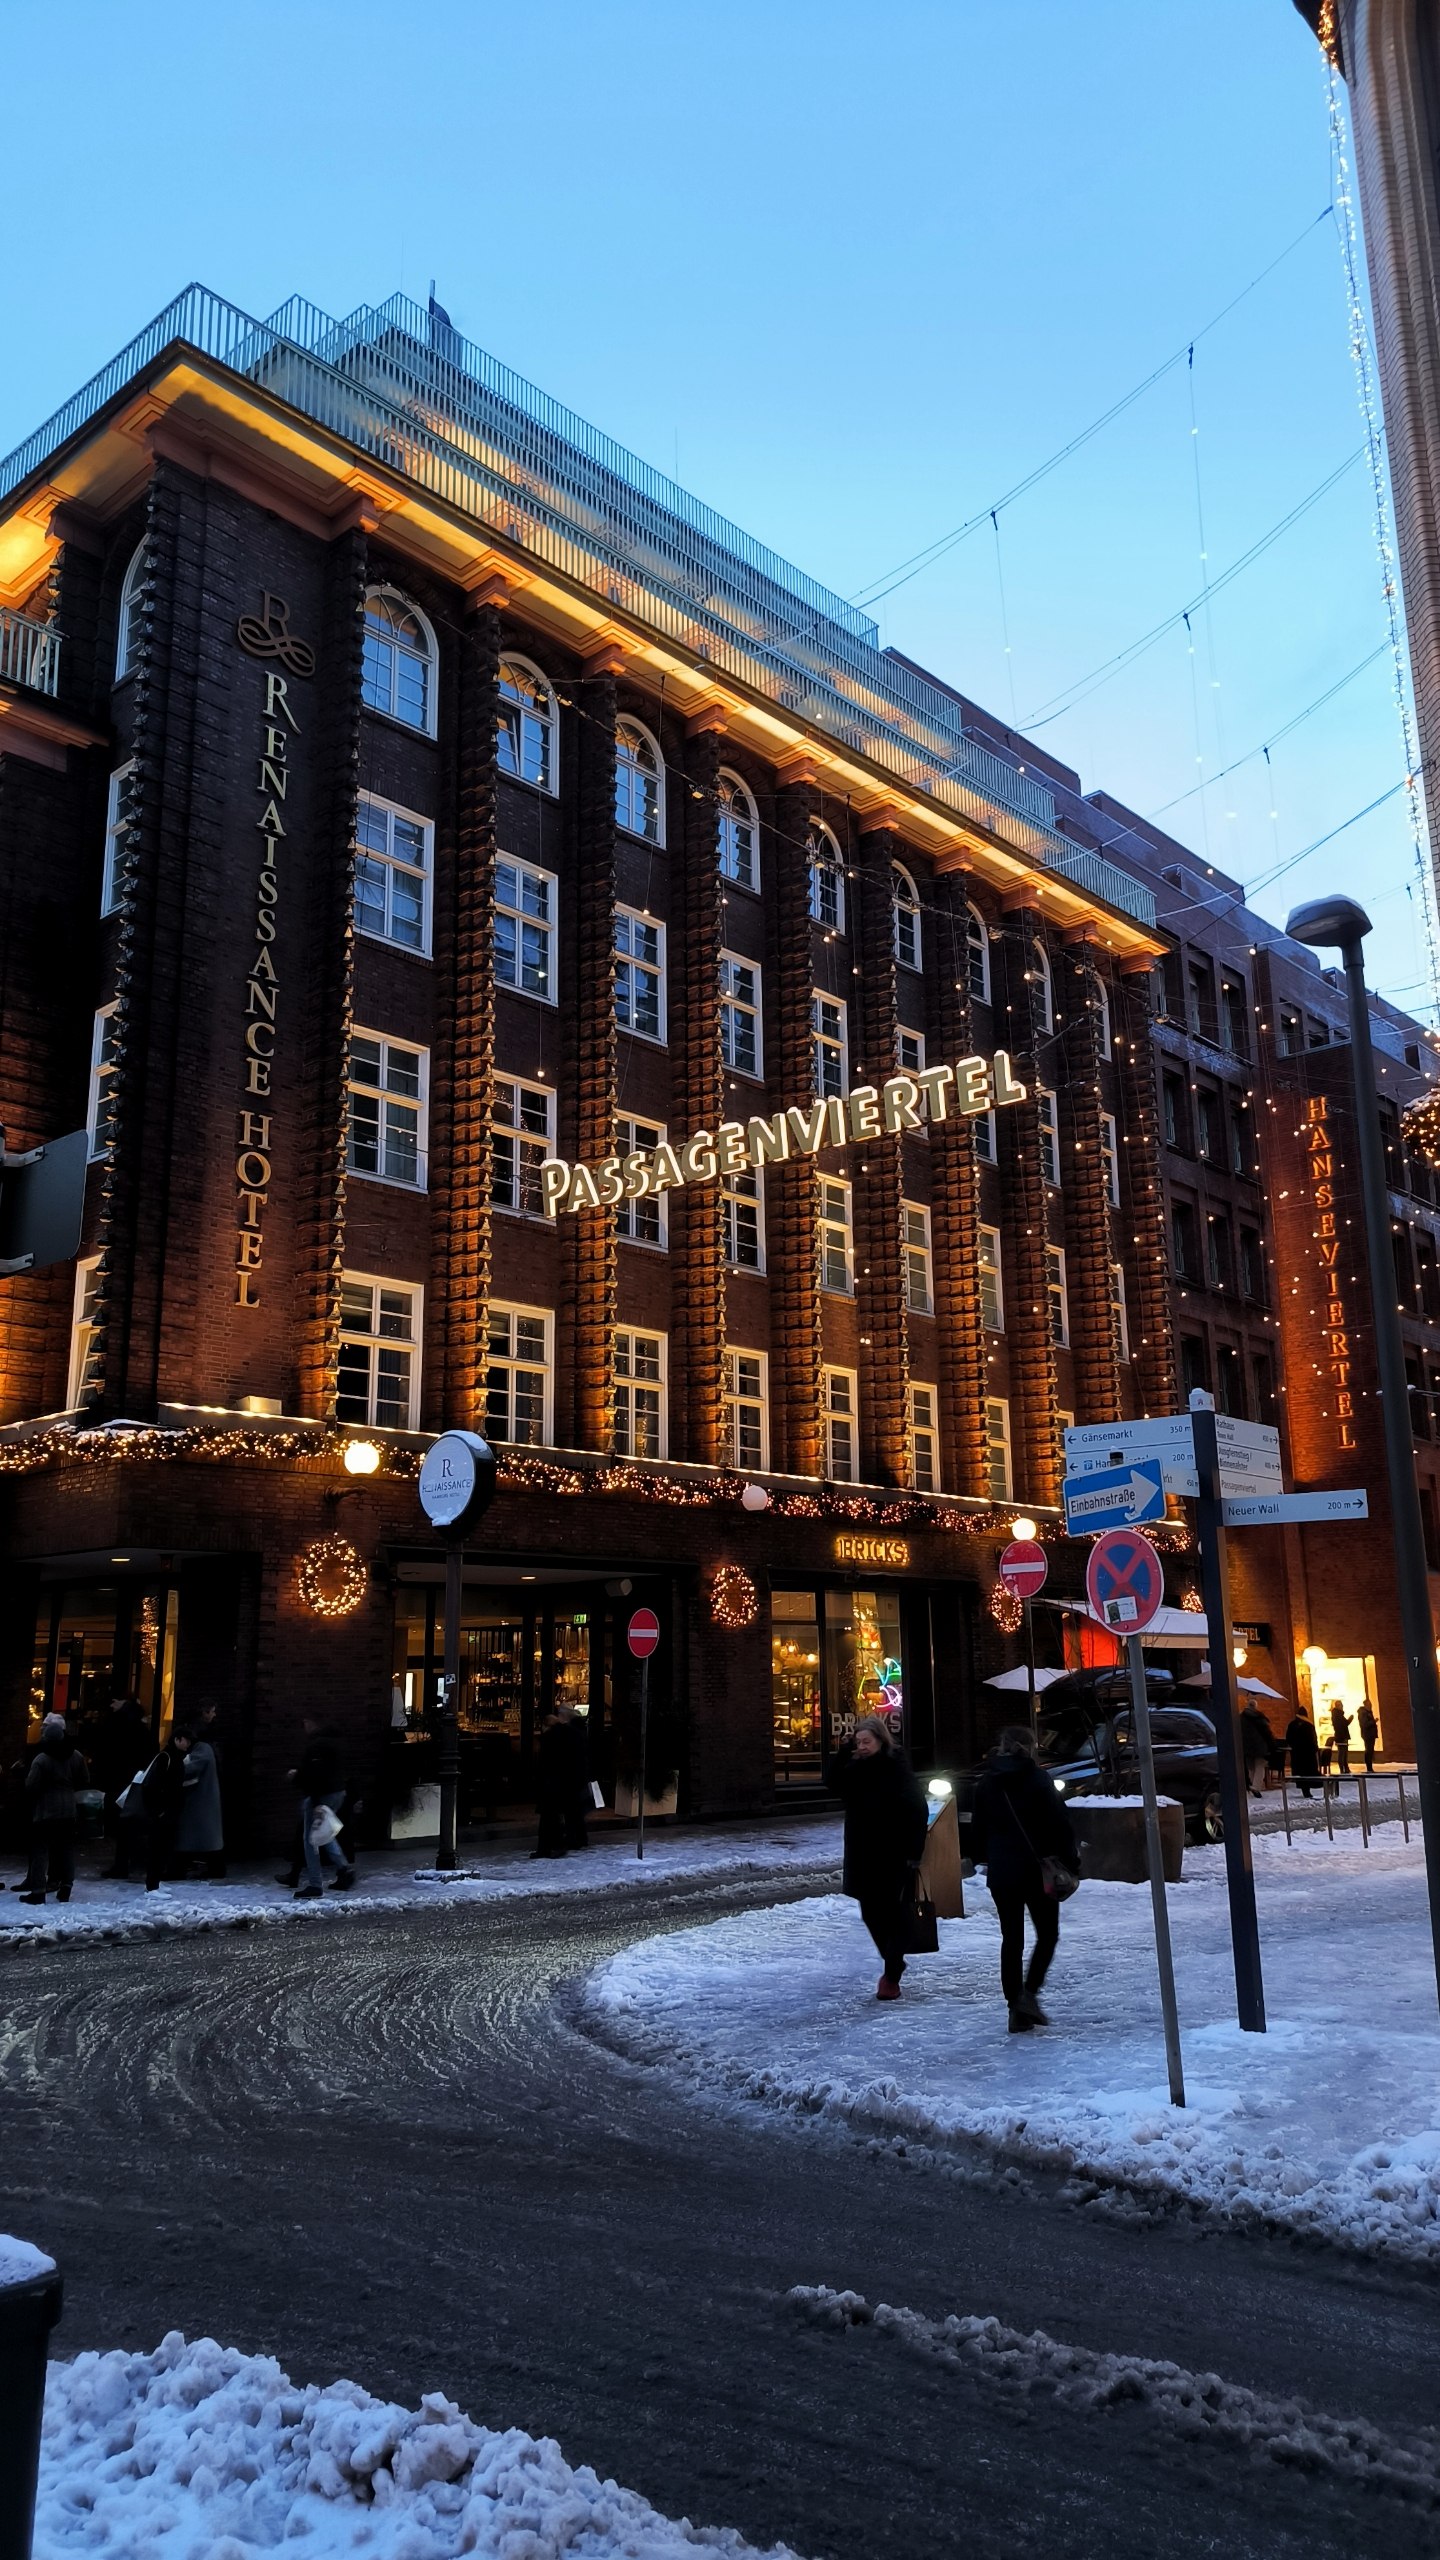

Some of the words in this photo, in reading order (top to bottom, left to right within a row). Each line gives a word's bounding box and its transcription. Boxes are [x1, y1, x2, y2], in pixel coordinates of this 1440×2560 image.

[244, 670, 302, 1097] RENAISSANCE
[540, 1049, 1027, 1219] PASSAGENVIERTEL
[234, 1110, 273, 1308] HOTEL
[1307, 1095, 1357, 1449] HANSEVIERTEL
[1081, 1429, 1134, 1443] Gänsemarkt
[1170, 1426, 1183, 1434] 350
[442, 1459, 454, 1478] R
[1173, 1454, 1185, 1462] 200
[1070, 1488, 1136, 1514] Einbahnstraße
[1228, 1505, 1256, 1516] Neuer
[1259, 1503, 1280, 1515] Wall
[1327, 1501, 1341, 1510] 200
[838, 1536, 907, 1563] BRICKS
[1413, 1656, 1419, 1668] 7
